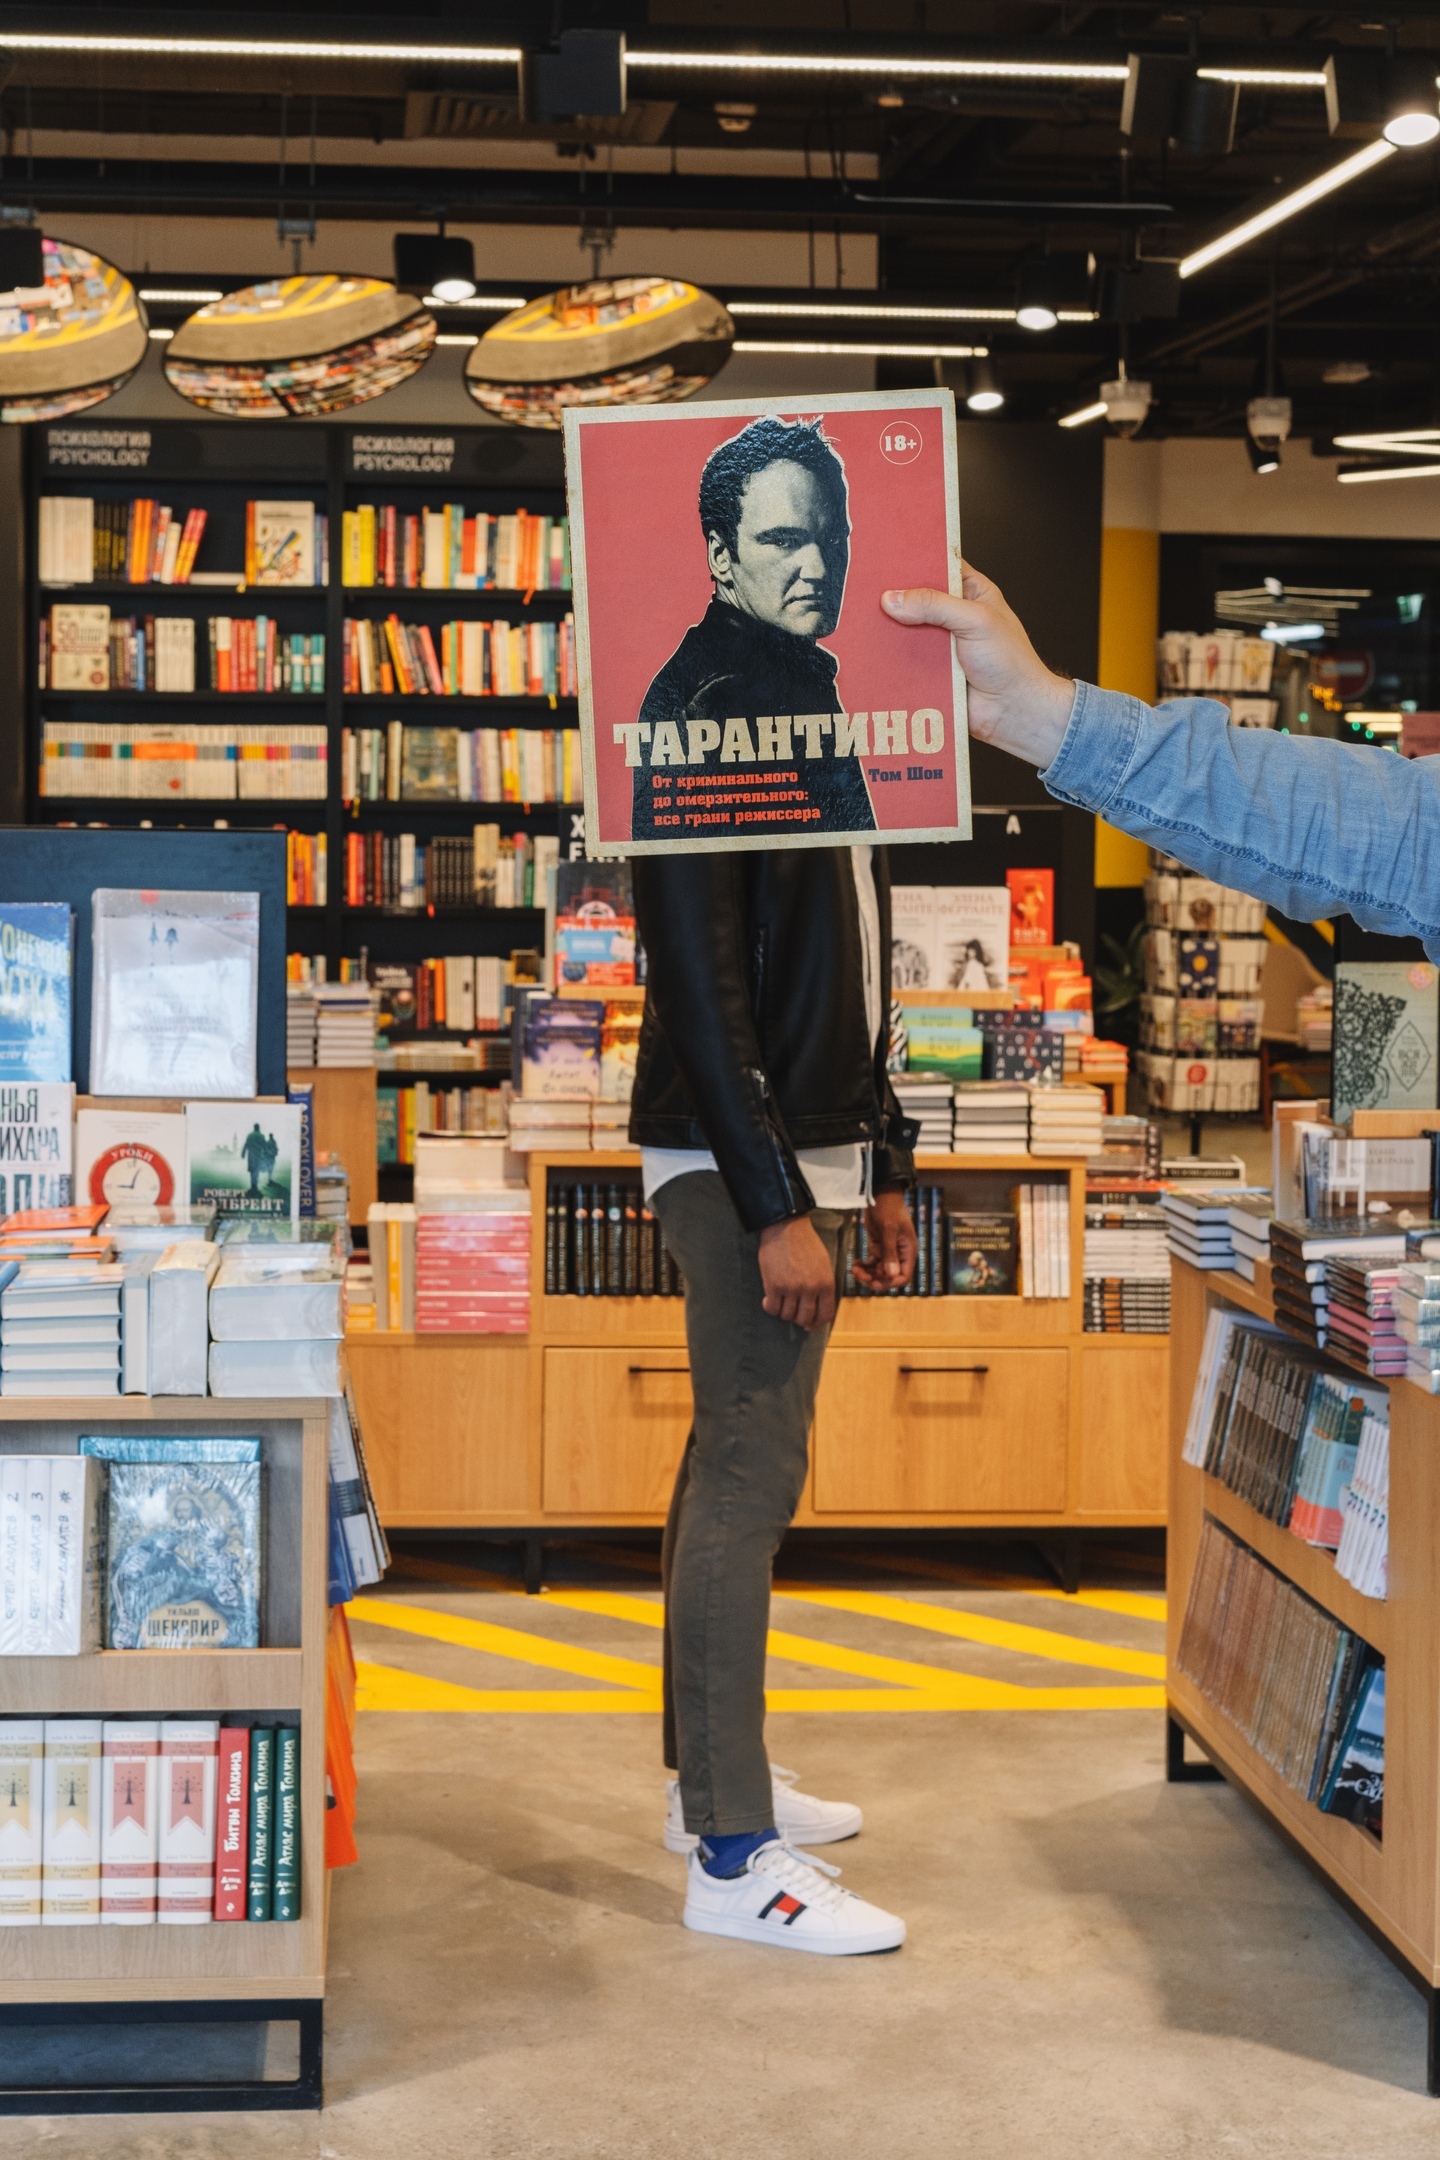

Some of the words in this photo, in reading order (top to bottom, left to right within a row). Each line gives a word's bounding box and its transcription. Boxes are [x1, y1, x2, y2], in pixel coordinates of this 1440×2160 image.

[885, 435, 917, 451] 18+
[49, 448, 150, 466] PSYCHOLOGY
[353, 454, 454, 472] PSYCHOLOGY
[613, 708, 945, 767] ТАРАНТИНО
[652, 775, 672, 789] От
[676, 771, 798, 790] криминального
[868, 768, 902, 782] Том
[907, 766, 943, 781] Шон
[653, 796, 672, 809] до
[676, 790, 809, 808] омерзительного:
[654, 814, 681, 826] все
[685, 811, 730, 828] грани
[734, 807, 821, 826] режиссера
[111, 1148, 154, 1163] УРОКИ
[204, 1188, 247, 1198] РОБЕРТ
[196, 1197, 285, 1212] ГЭЛБРЕЙТ
[8, 1492, 19, 1503] 2
[31, 1491, 44, 1501] 3
[148, 1619, 220, 1637] ШЕКСПИР
[254, 1740, 270, 1792] Толкина
[280, 1739, 296, 1792] Толкина
[226, 1751, 243, 1804] Толкина
[256, 1795, 272, 1829] мира
[283, 1794, 298, 1829] мира
[224, 1808, 241, 1852] Битвы
[252, 1831, 267, 1867] Атлас
[278, 1830, 294, 1866] Атлас
